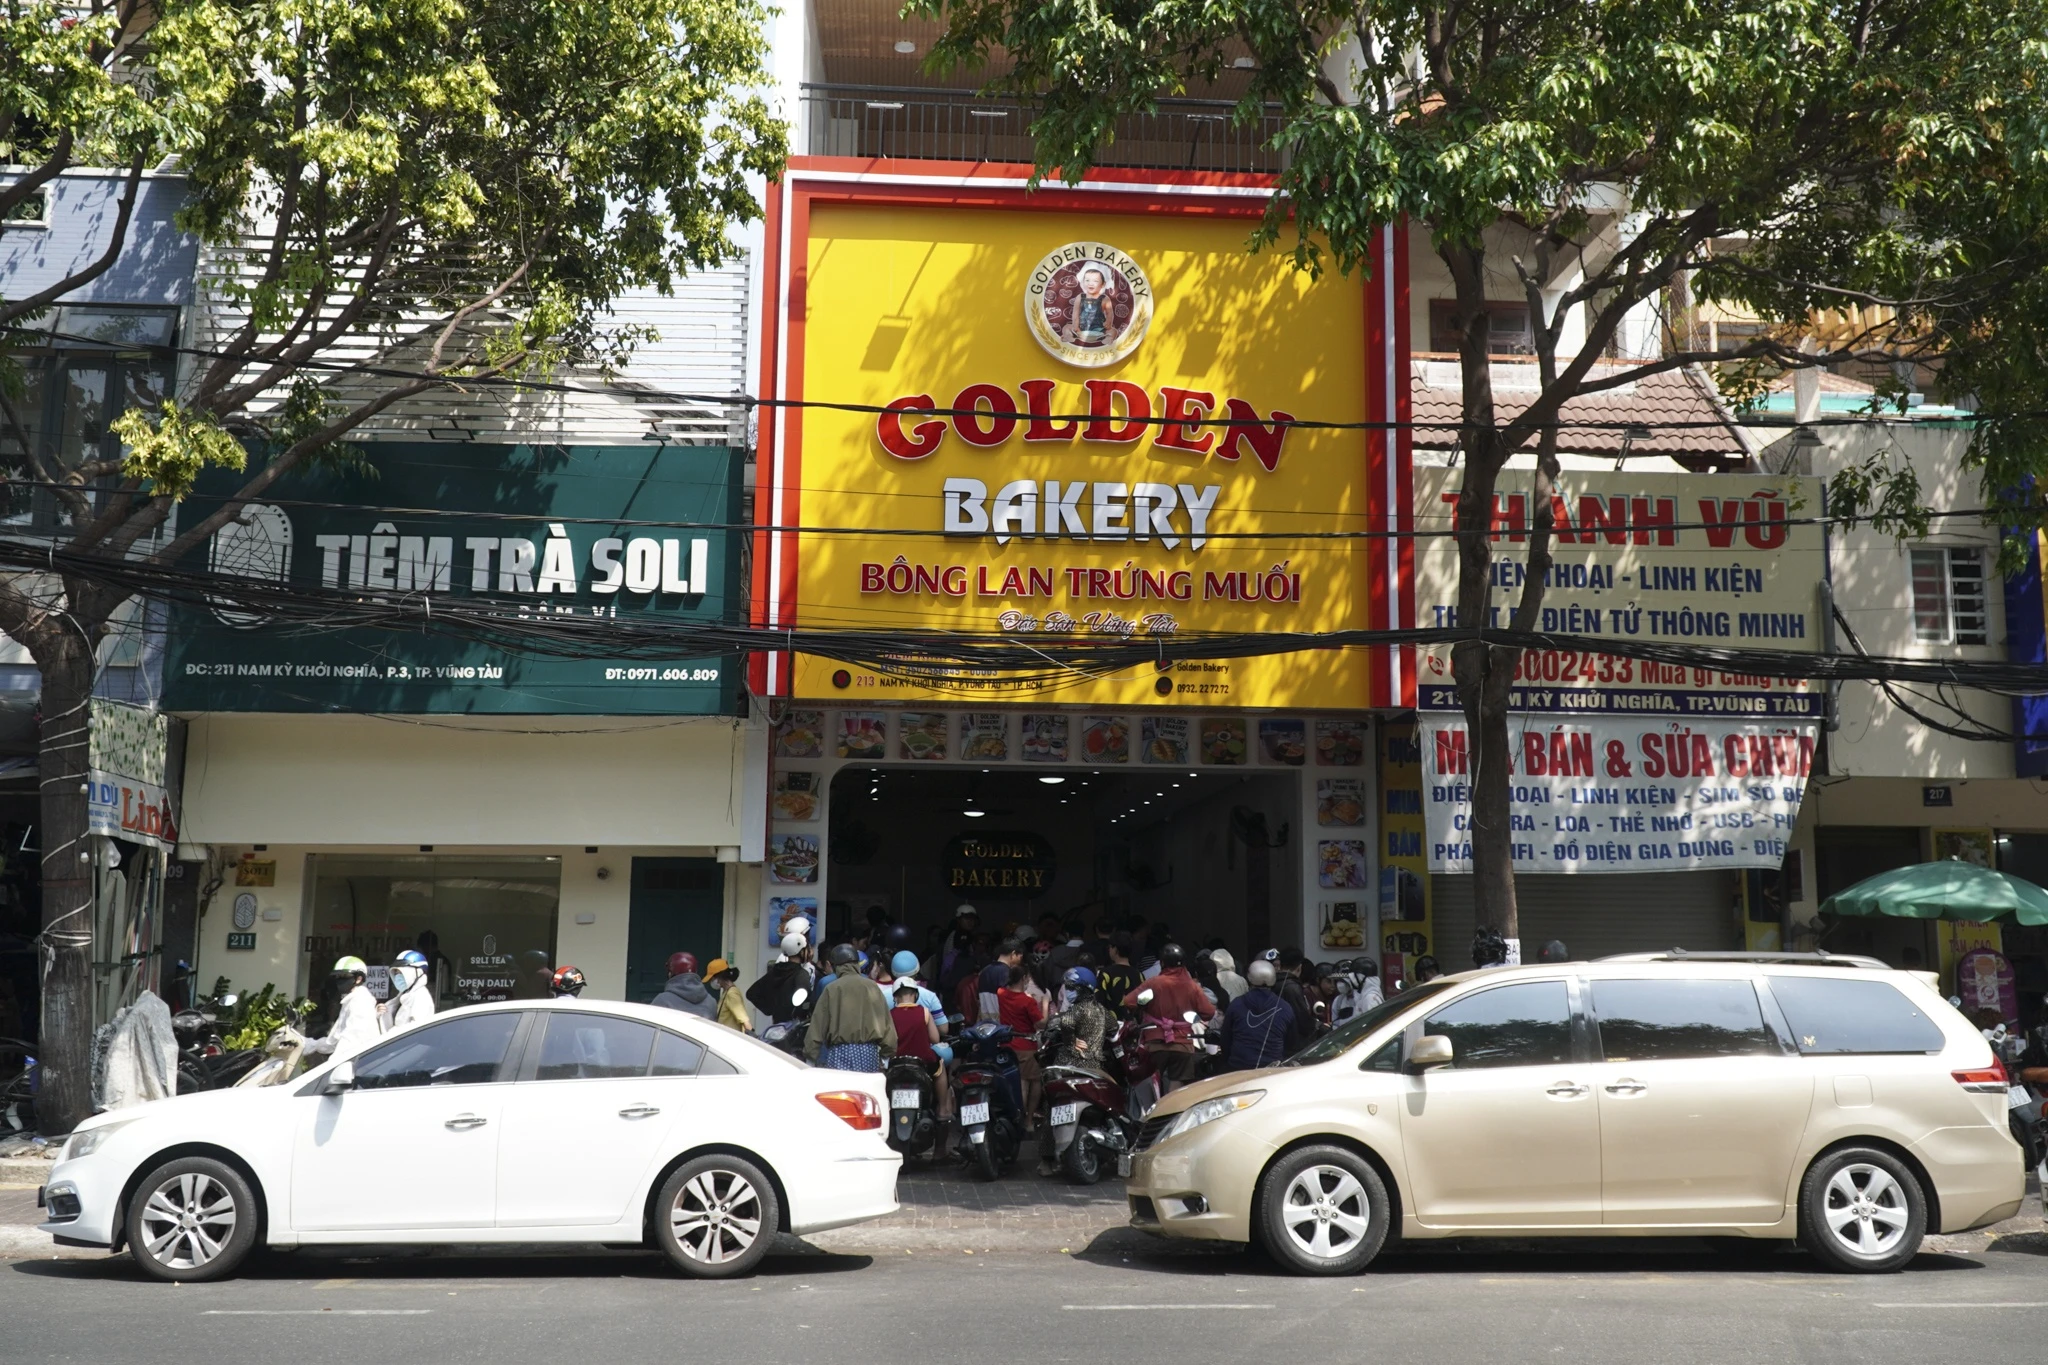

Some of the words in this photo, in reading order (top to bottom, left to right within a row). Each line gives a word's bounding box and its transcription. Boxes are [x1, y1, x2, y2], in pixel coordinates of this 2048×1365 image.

[1030, 245, 1086, 295] GOLDEN
[1094, 246, 1149, 298] BAKERY
[1060, 347, 1090, 360] SINCE
[1094, 349, 1115, 360] 2015
[877, 378, 1297, 472] GOLDEN
[942, 477, 1222, 552] BAKERY
[1698, 490, 1789, 549] VŨ
[466, 523, 577, 594] TRÀ
[591, 537, 708, 595] SOLI
[860, 555, 967, 596] BÔNG
[977, 565, 1053, 598] LAN
[1066, 561, 1192, 601] TRỨNG
[1204, 560, 1301, 603] MUỐI
[1491, 557, 1528, 592] IỆN
[1640, 565, 1696, 591] LINH
[1705, 563, 1763, 598] KIỆN
[1433, 606, 1501, 628] THT
[1543, 604, 1601, 637] ĐIỆN
[1609, 602, 1643, 635] TỬ
[1648, 604, 1730, 638] THÔNG
[1739, 613, 1805, 639] MINH
[186, 663, 212, 676] ĐC:
[214, 664, 234, 676] 211
[238, 664, 271, 677] NAM
[274, 661, 292, 677] KỲ
[295, 661, 331, 678] KHỞI
[334, 662, 383, 680] NGHĨA,
[387, 667, 412, 680] P.3,
[415, 667, 432, 679] TP.
[436, 663, 475, 678] VŨNG
[476, 663, 503, 679] TÀU
[1177, 662, 1202, 672] Golden
[1203, 663, 1229, 674] Bakery
[1641, 661, 1687, 684] Mua
[856, 676, 875, 686] 213
[880, 678, 898, 688] NAM
[1026, 681, 1043, 690] HCM
[1431, 691, 1463, 706] 21
[1529, 690, 1553, 707] KỲ
[1560, 688, 1608, 710] KHỞI
[1613, 692, 1681, 712] NGHĨA,
[1687, 694, 1767, 712] TP.VŨNG
[1772, 696, 1810, 713] TÀU
[1524, 725, 1594, 777] BÁN
[1606, 739, 1631, 778] &
[1642, 723, 1714, 778] SỬA
[1387, 790, 1422, 814] MUA
[1432, 782, 1472, 805] ĐIỆ
[1510, 786, 1550, 807] OẠI
[1571, 787, 1618, 805] LINH
[1626, 785, 1676, 809] KIỆN
[1699, 787, 1739, 803] SIM
[1929, 789, 1945, 799] 217
[1453, 814, 1535, 831] CRA
[1555, 814, 1590, 832] LOA
[1609, 811, 1648, 833] THẺ
[1652, 812, 1693, 832] NHỚ
[1714, 813, 1755, 828] USB
[1774, 813, 1795, 829] PI
[964, 843, 1035, 858] GOLDEN
[1389, 827, 1421, 857] BÁN
[1434, 840, 1473, 860] PHÁ
[1511, 843, 1534, 860] IFI
[1554, 838, 1580, 862] ĐỒ
[1586, 841, 1632, 864] ĐIỆN
[1639, 842, 1673, 859] GIA
[1679, 840, 1734, 861] DỤNG
[1754, 838, 1787, 861] ĐIỆ
[167, 865, 184, 878] 09
[952, 868, 1045, 887] BAKERY
[231, 935, 253, 947] 211
[470, 956, 489, 965] SOLI
[491, 956, 506, 965] TEA
[458, 979, 485, 988] OPEN
[487, 979, 515, 988] DAILY
